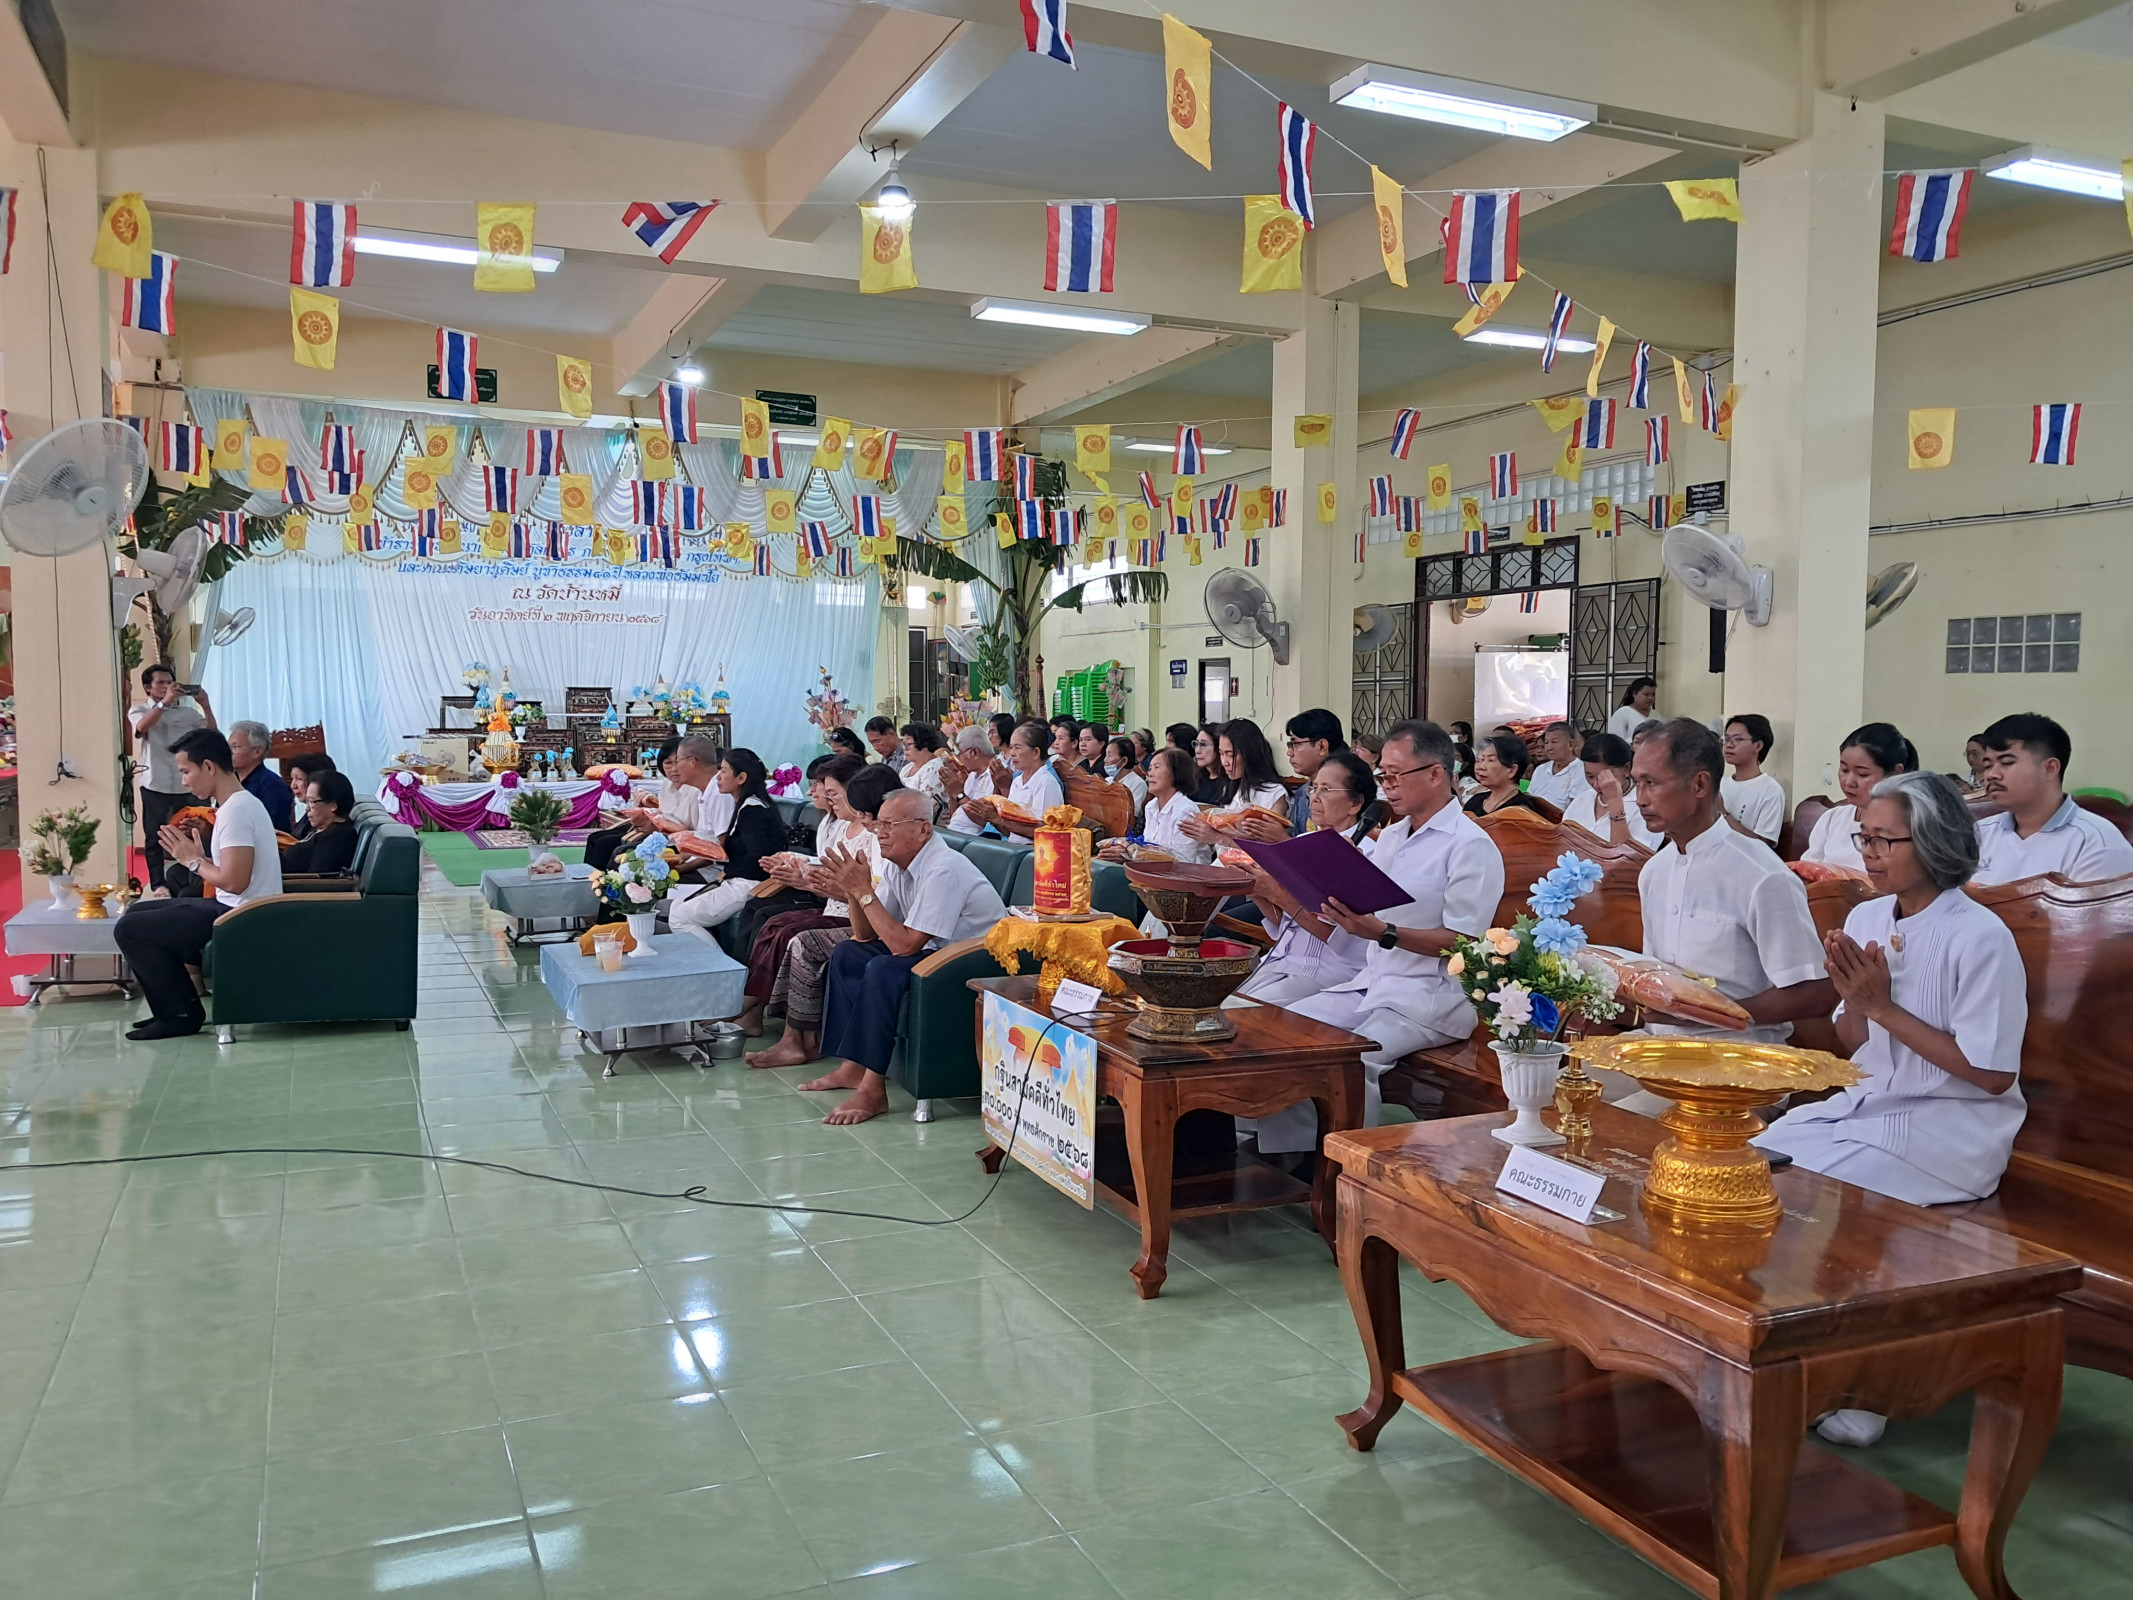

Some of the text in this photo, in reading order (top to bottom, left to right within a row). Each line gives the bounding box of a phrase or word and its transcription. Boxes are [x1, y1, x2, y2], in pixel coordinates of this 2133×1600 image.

[994, 1060, 1076, 1126] กฐินสามัคคีทั่วไทย
[1508, 1168, 1588, 1208] คณะธรรมกาย
